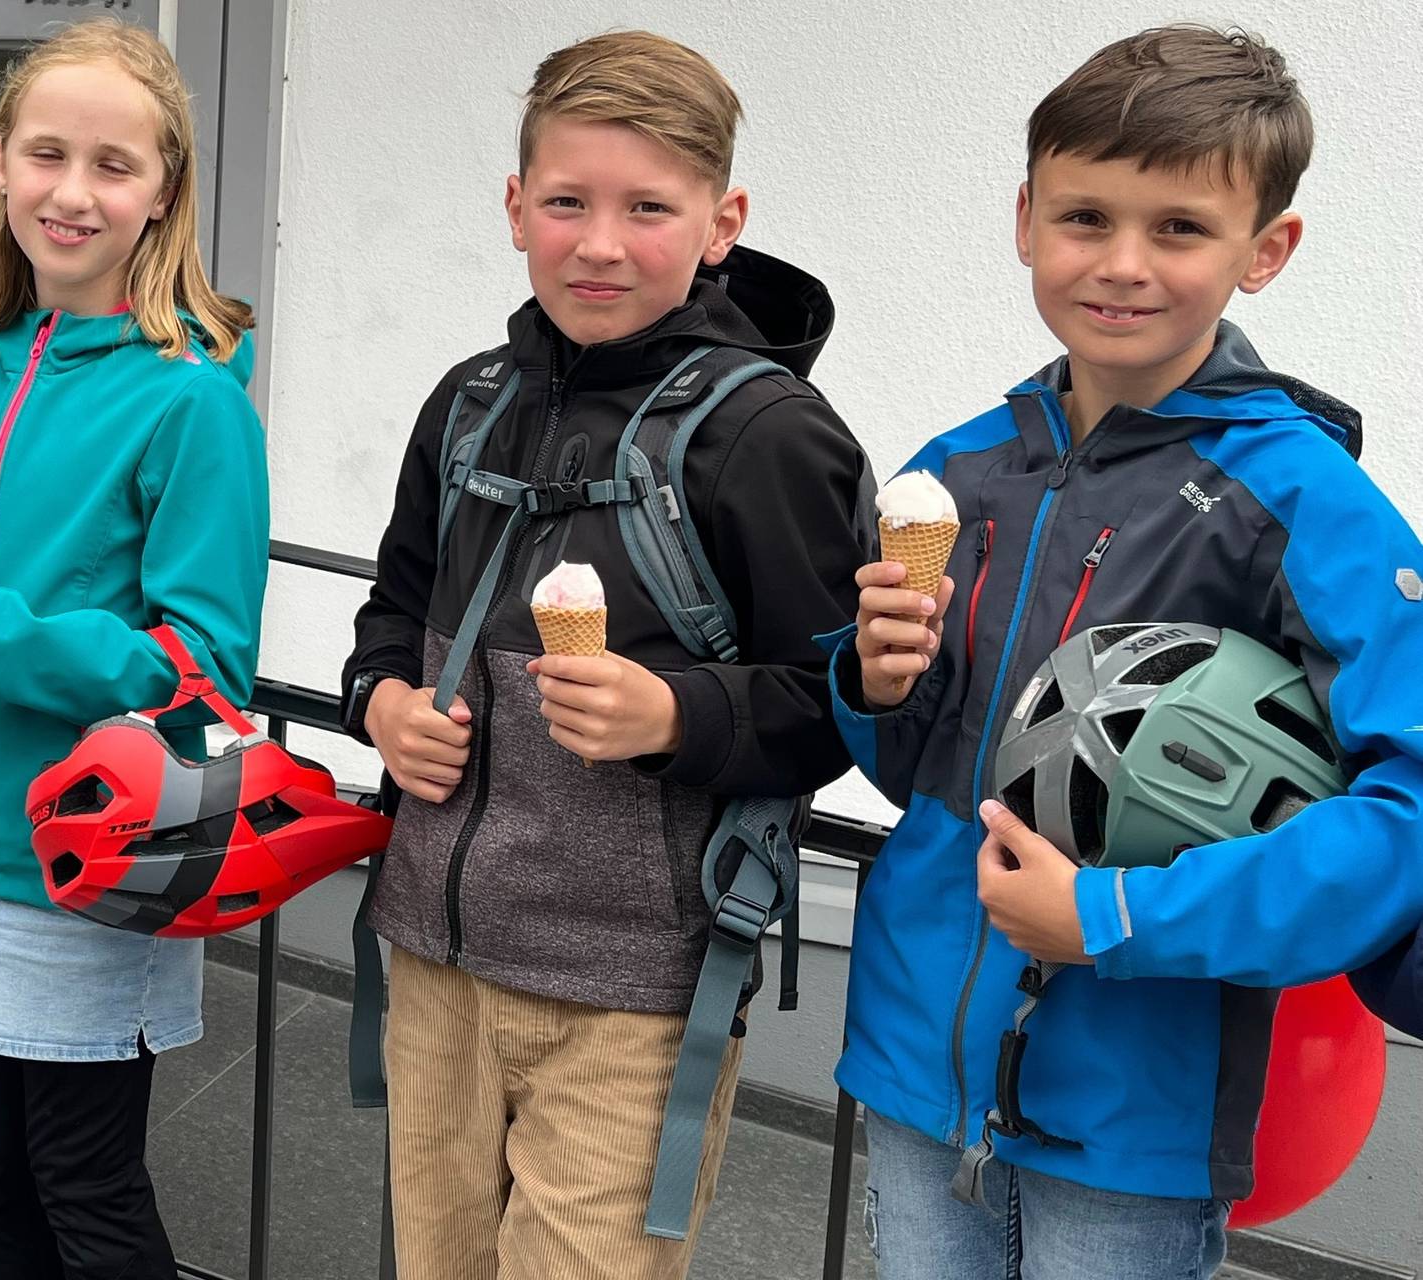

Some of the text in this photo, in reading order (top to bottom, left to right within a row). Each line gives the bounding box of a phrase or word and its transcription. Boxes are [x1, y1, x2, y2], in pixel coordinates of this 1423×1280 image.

[466, 379, 501, 390] deuter
[659, 389, 690, 397] deuter
[468, 477, 504, 500] deuter
[1121, 628, 1191, 655] uvex
[107, 819, 151, 834] BELL
